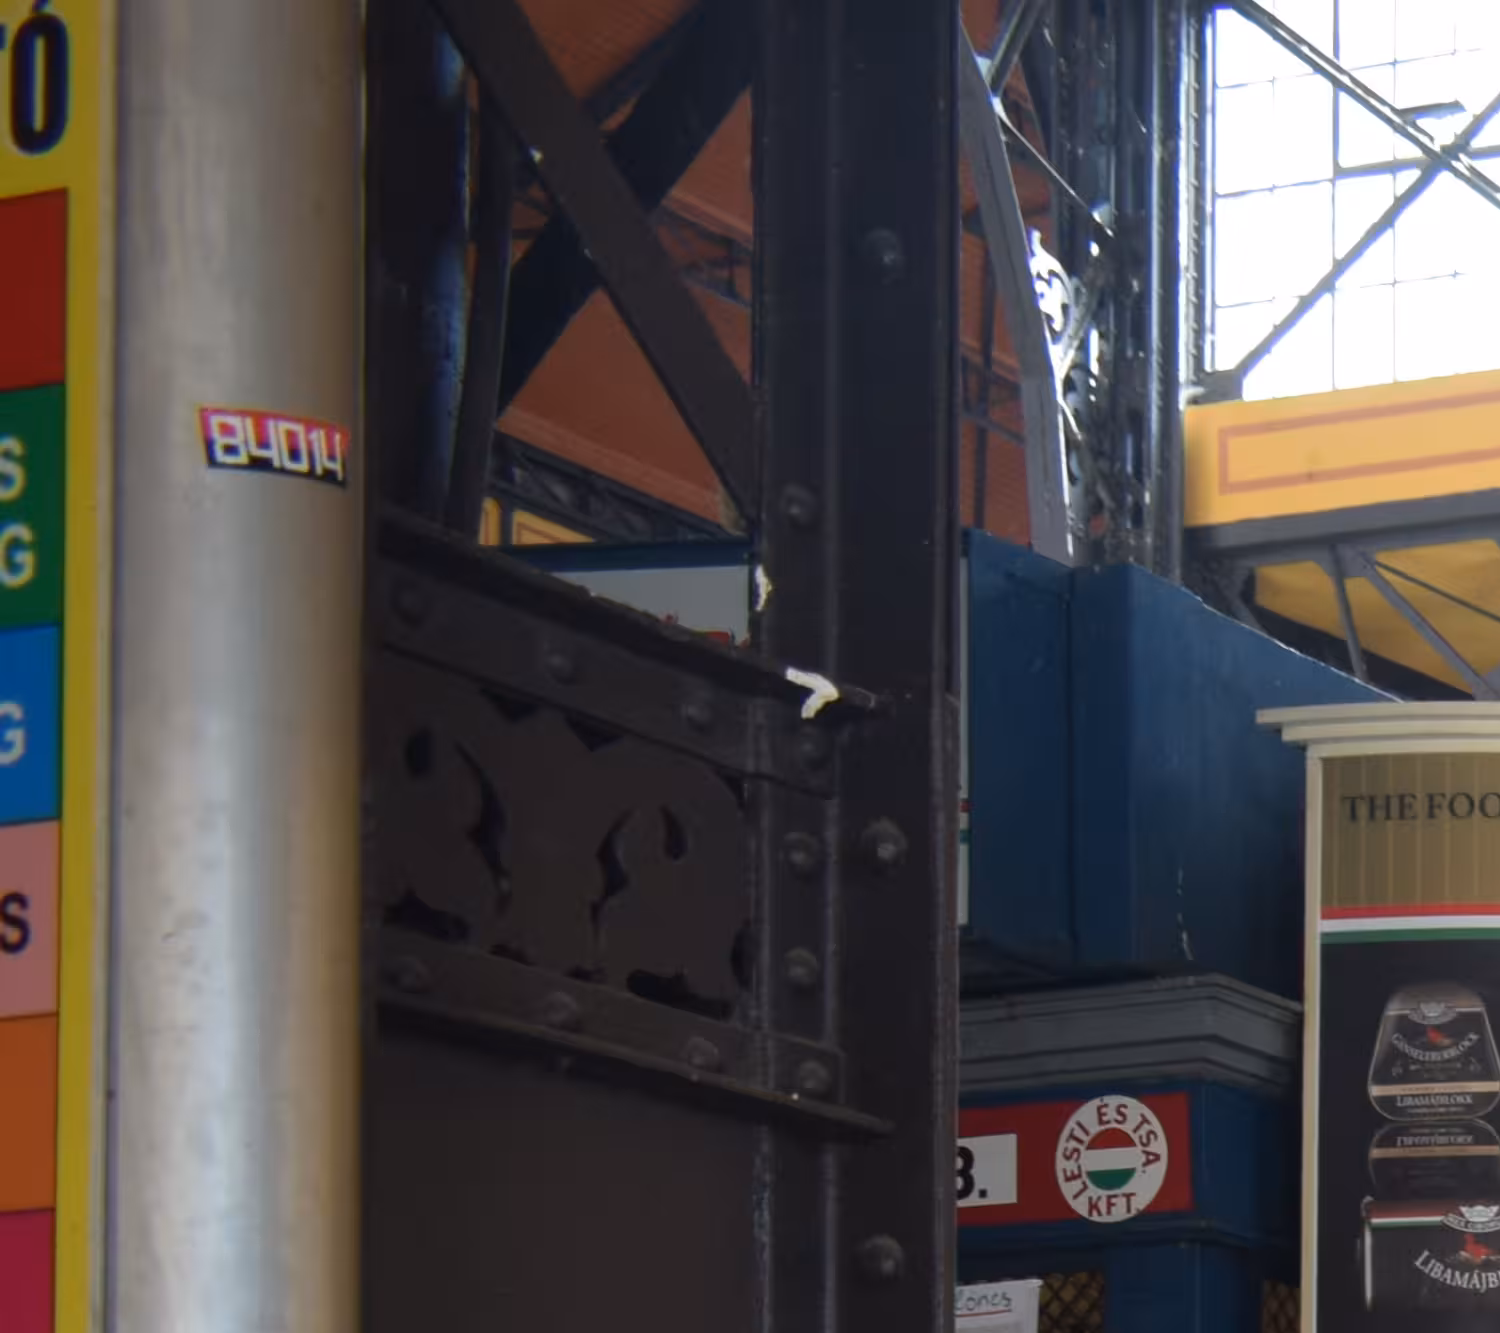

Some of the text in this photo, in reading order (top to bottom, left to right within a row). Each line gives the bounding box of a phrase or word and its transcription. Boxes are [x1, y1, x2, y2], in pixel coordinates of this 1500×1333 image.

[0, 0, 70, 153] Ó
[1345, 793, 1418, 823] THE
[1063, 1120, 1090, 1200] LESTI
